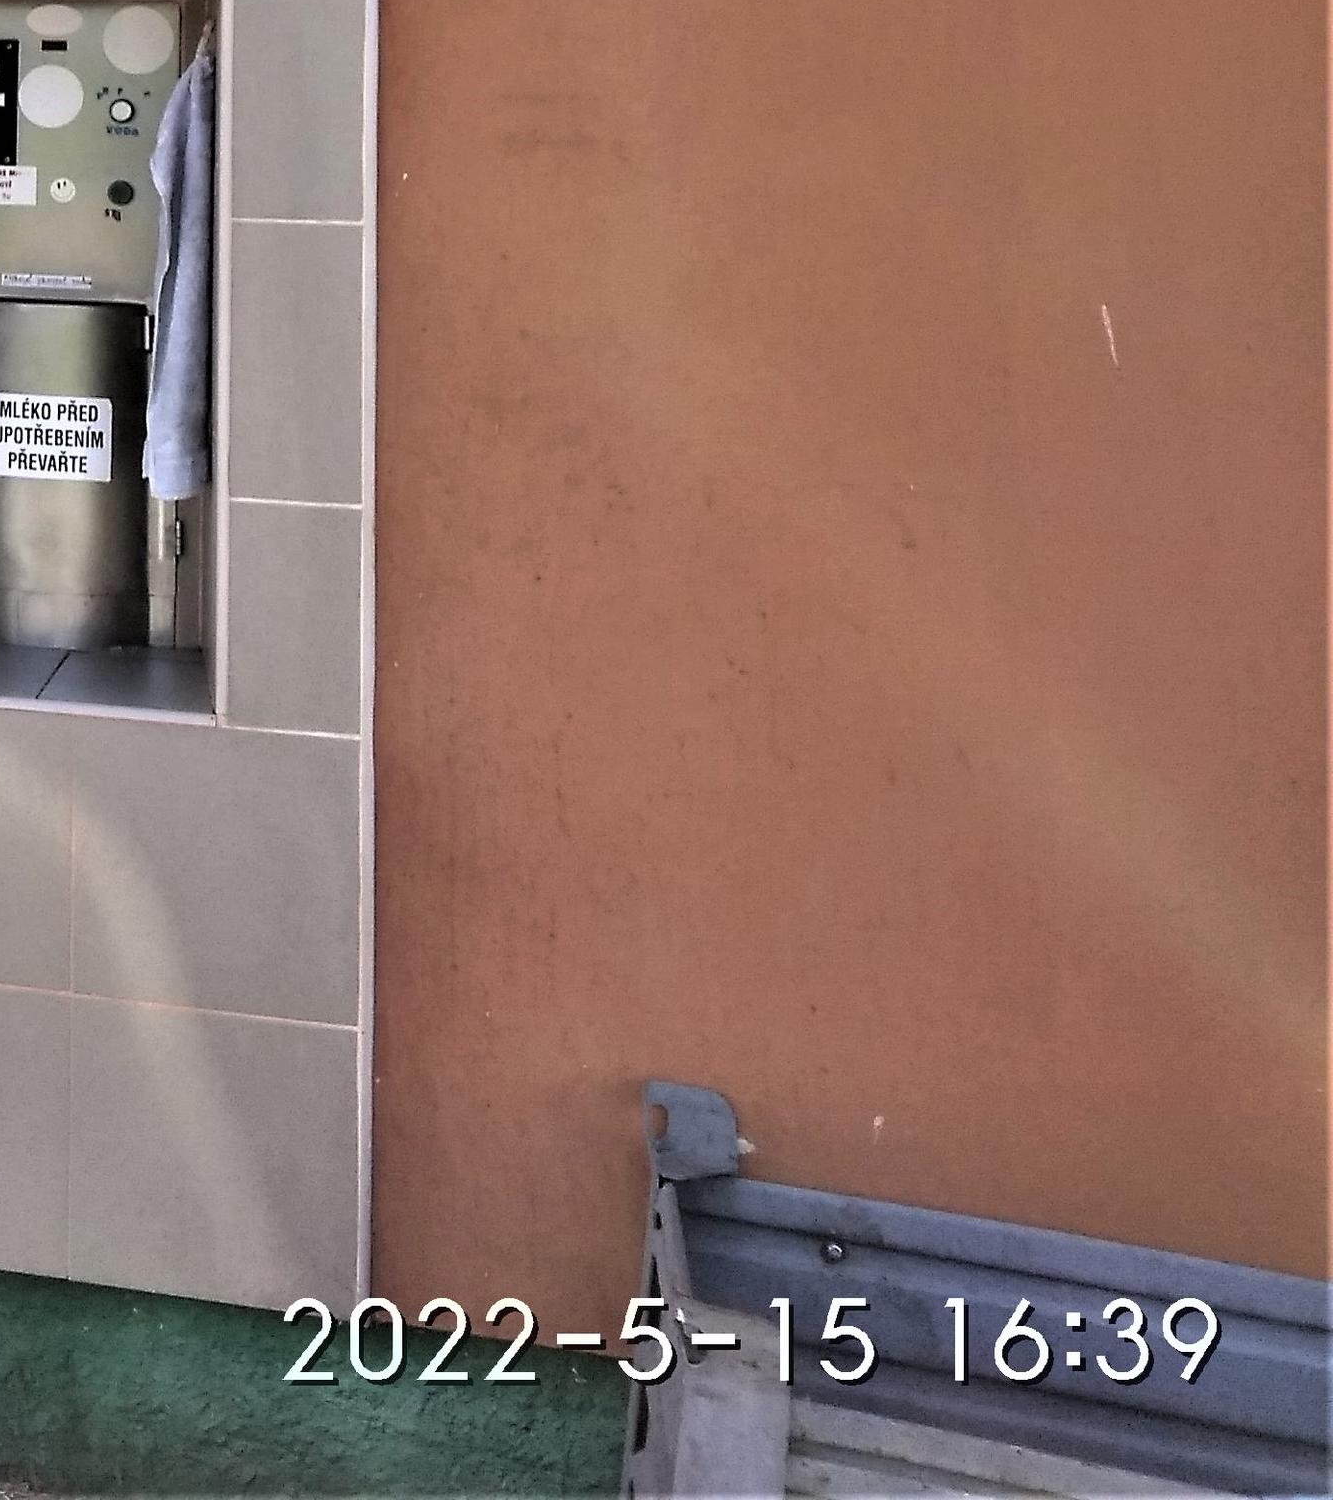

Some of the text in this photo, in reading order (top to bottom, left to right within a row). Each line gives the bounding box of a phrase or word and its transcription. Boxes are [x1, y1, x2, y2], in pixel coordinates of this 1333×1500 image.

[0, 397, 98, 422] MLÉKO PŘED
[8, 448, 87, 473] PŘEVAŘTE
